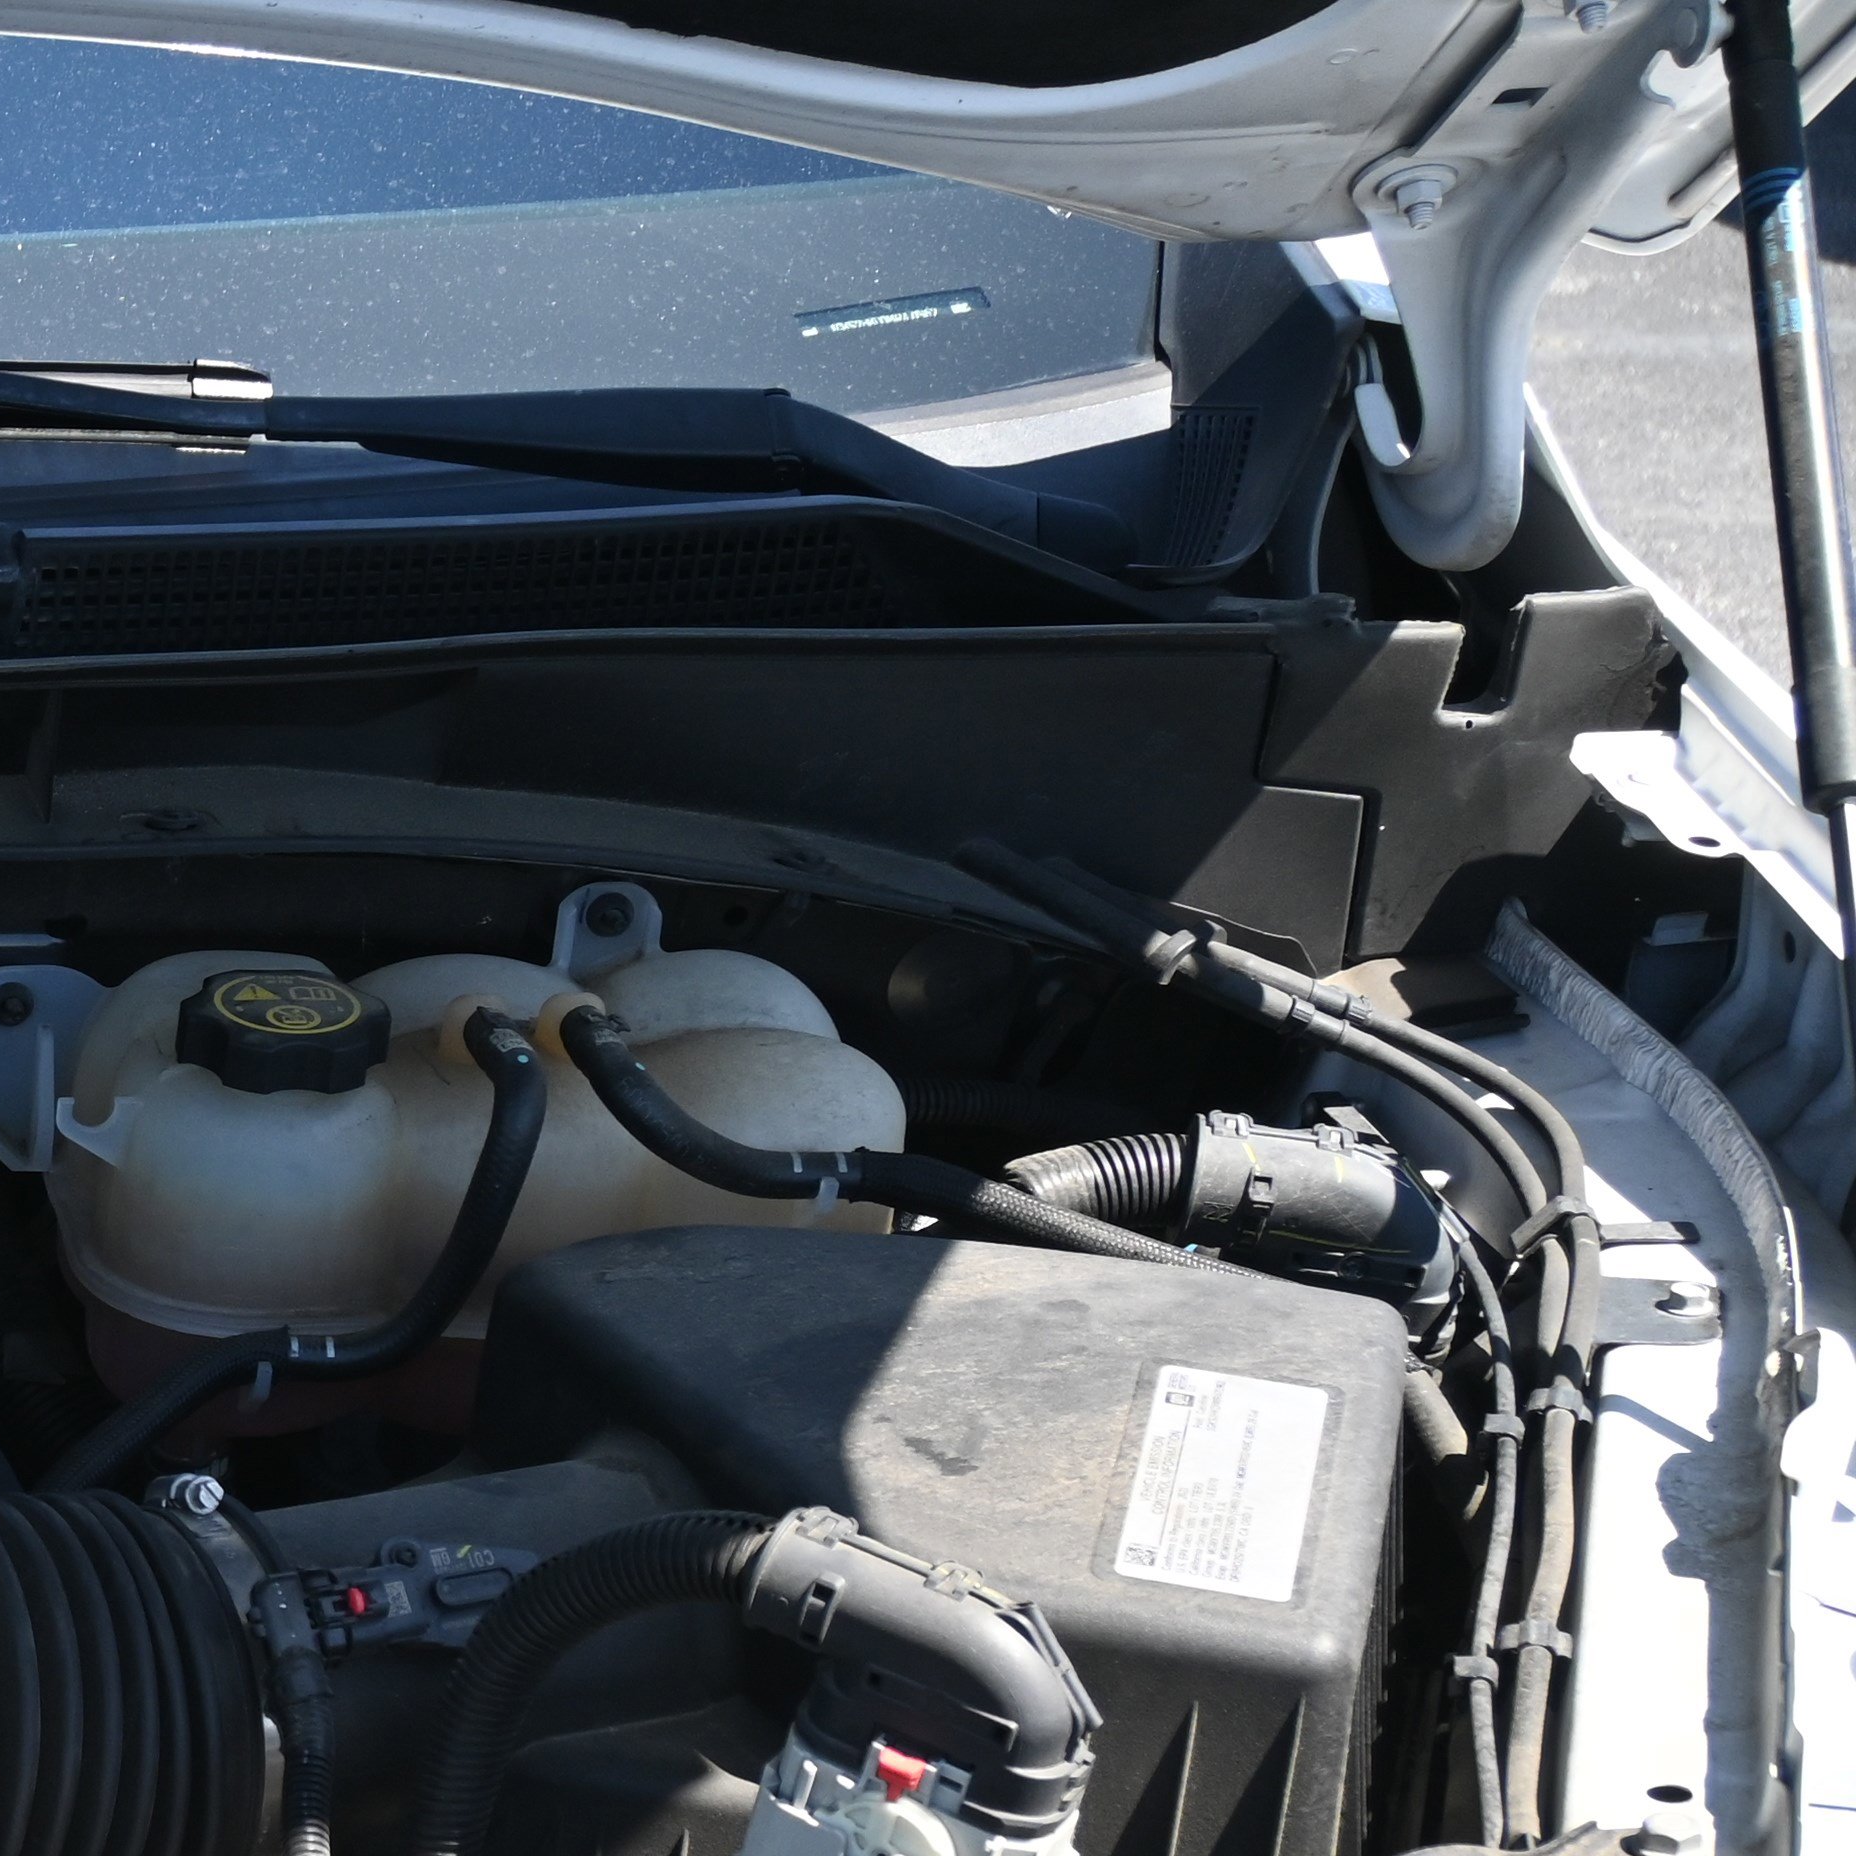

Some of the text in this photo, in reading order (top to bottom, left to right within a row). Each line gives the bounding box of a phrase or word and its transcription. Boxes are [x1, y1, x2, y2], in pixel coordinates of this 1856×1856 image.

[1139, 1434, 1165, 1502] VEHICLE EMISSION
[1152, 1429, 1181, 1514] CONTROL INFORMATION
